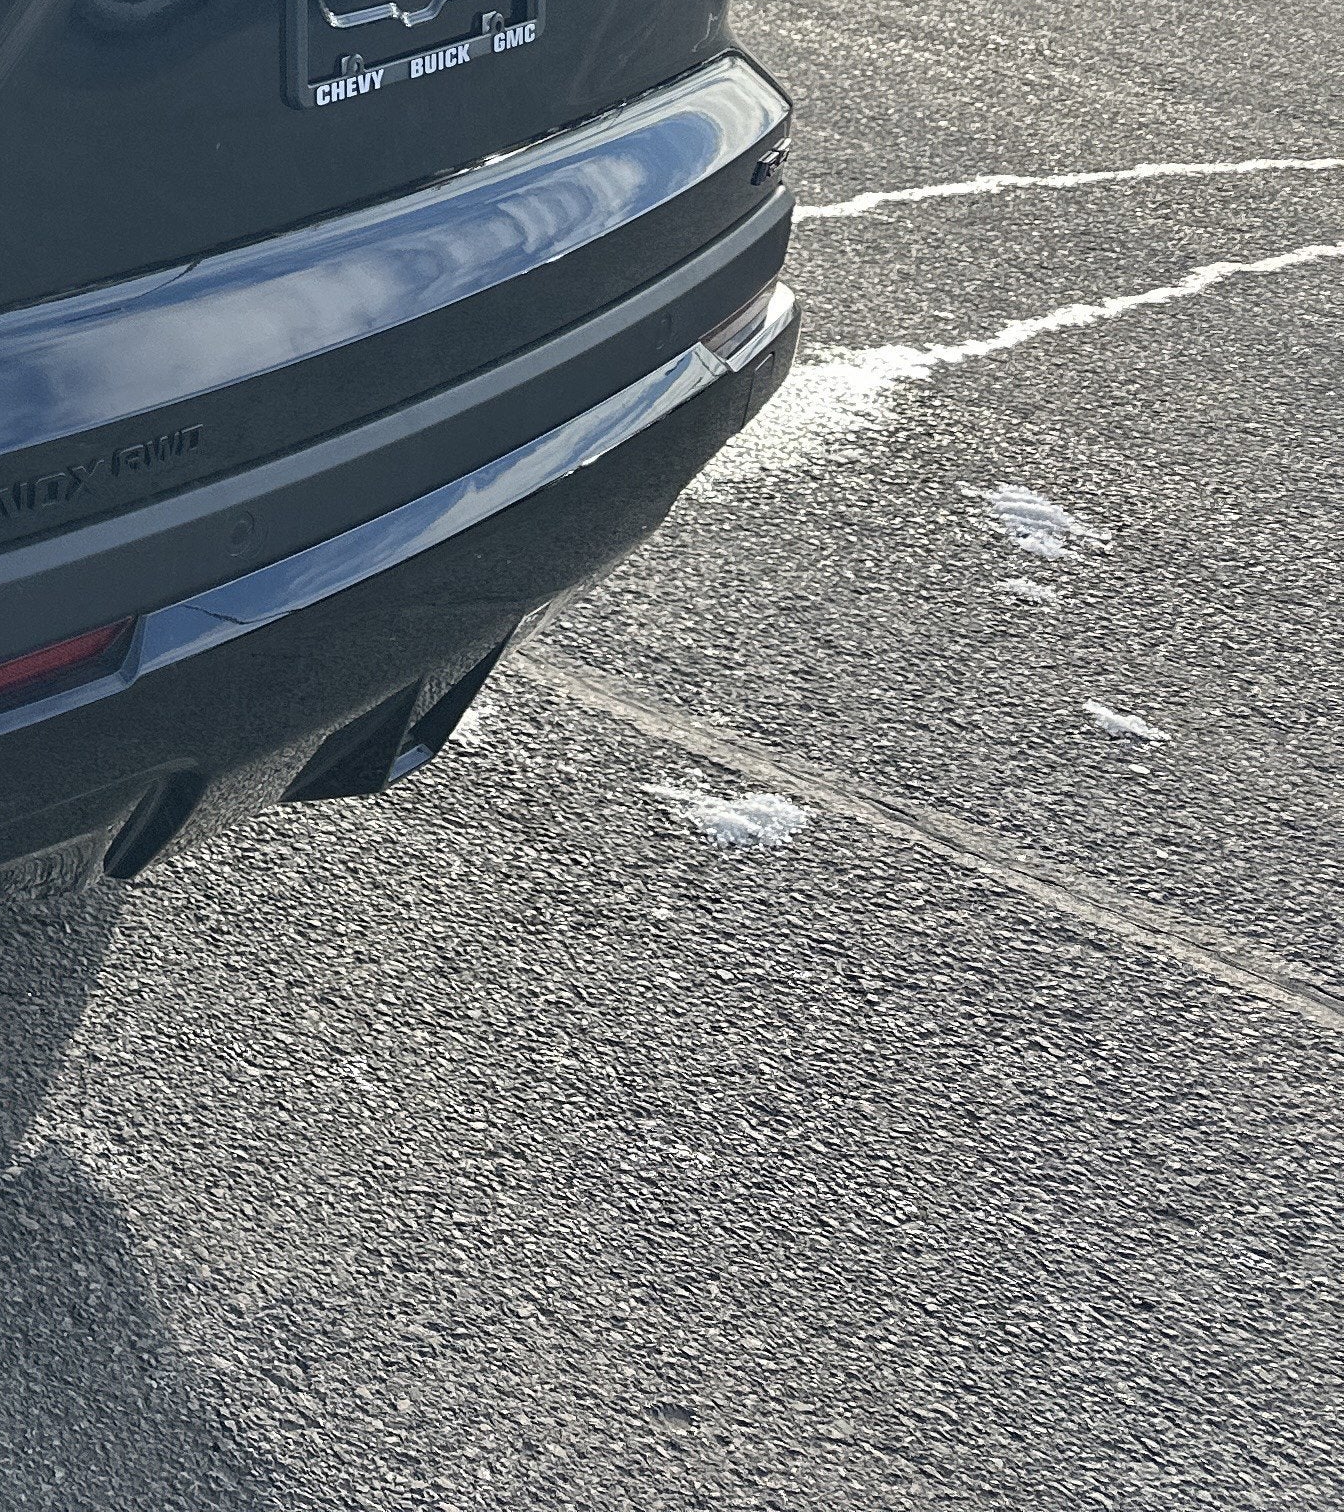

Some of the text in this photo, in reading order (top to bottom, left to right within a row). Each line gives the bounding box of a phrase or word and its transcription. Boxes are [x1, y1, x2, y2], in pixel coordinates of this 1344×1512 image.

[315, 22, 536, 107] CHEVY BUICK GMC
